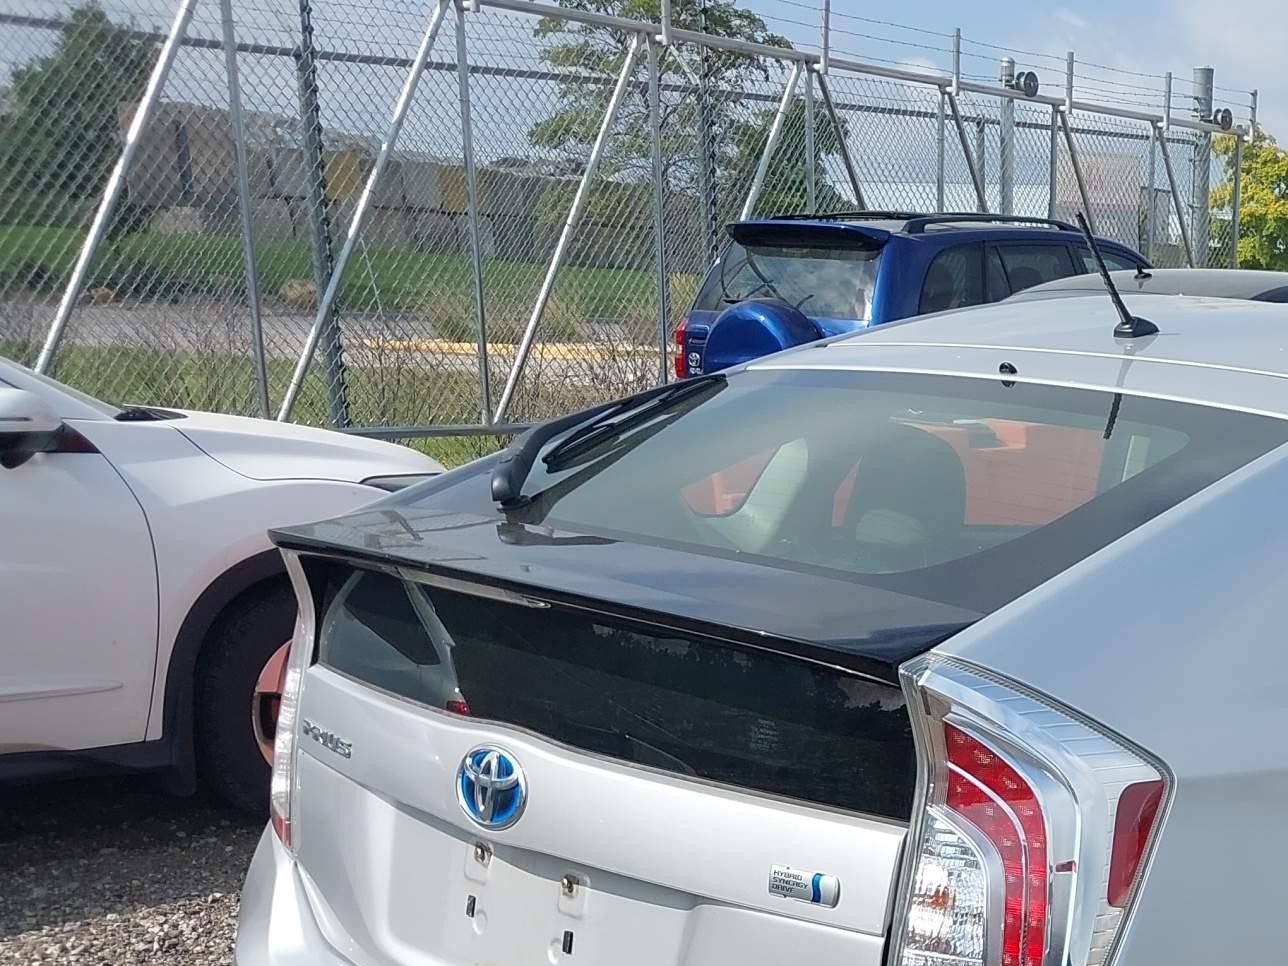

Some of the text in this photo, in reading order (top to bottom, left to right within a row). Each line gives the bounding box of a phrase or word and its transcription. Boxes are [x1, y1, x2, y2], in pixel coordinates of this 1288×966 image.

[773, 869, 803, 881] HYBRID
[771, 883, 796, 894] DRIVE
[772, 876, 809, 889] SYNERGY
